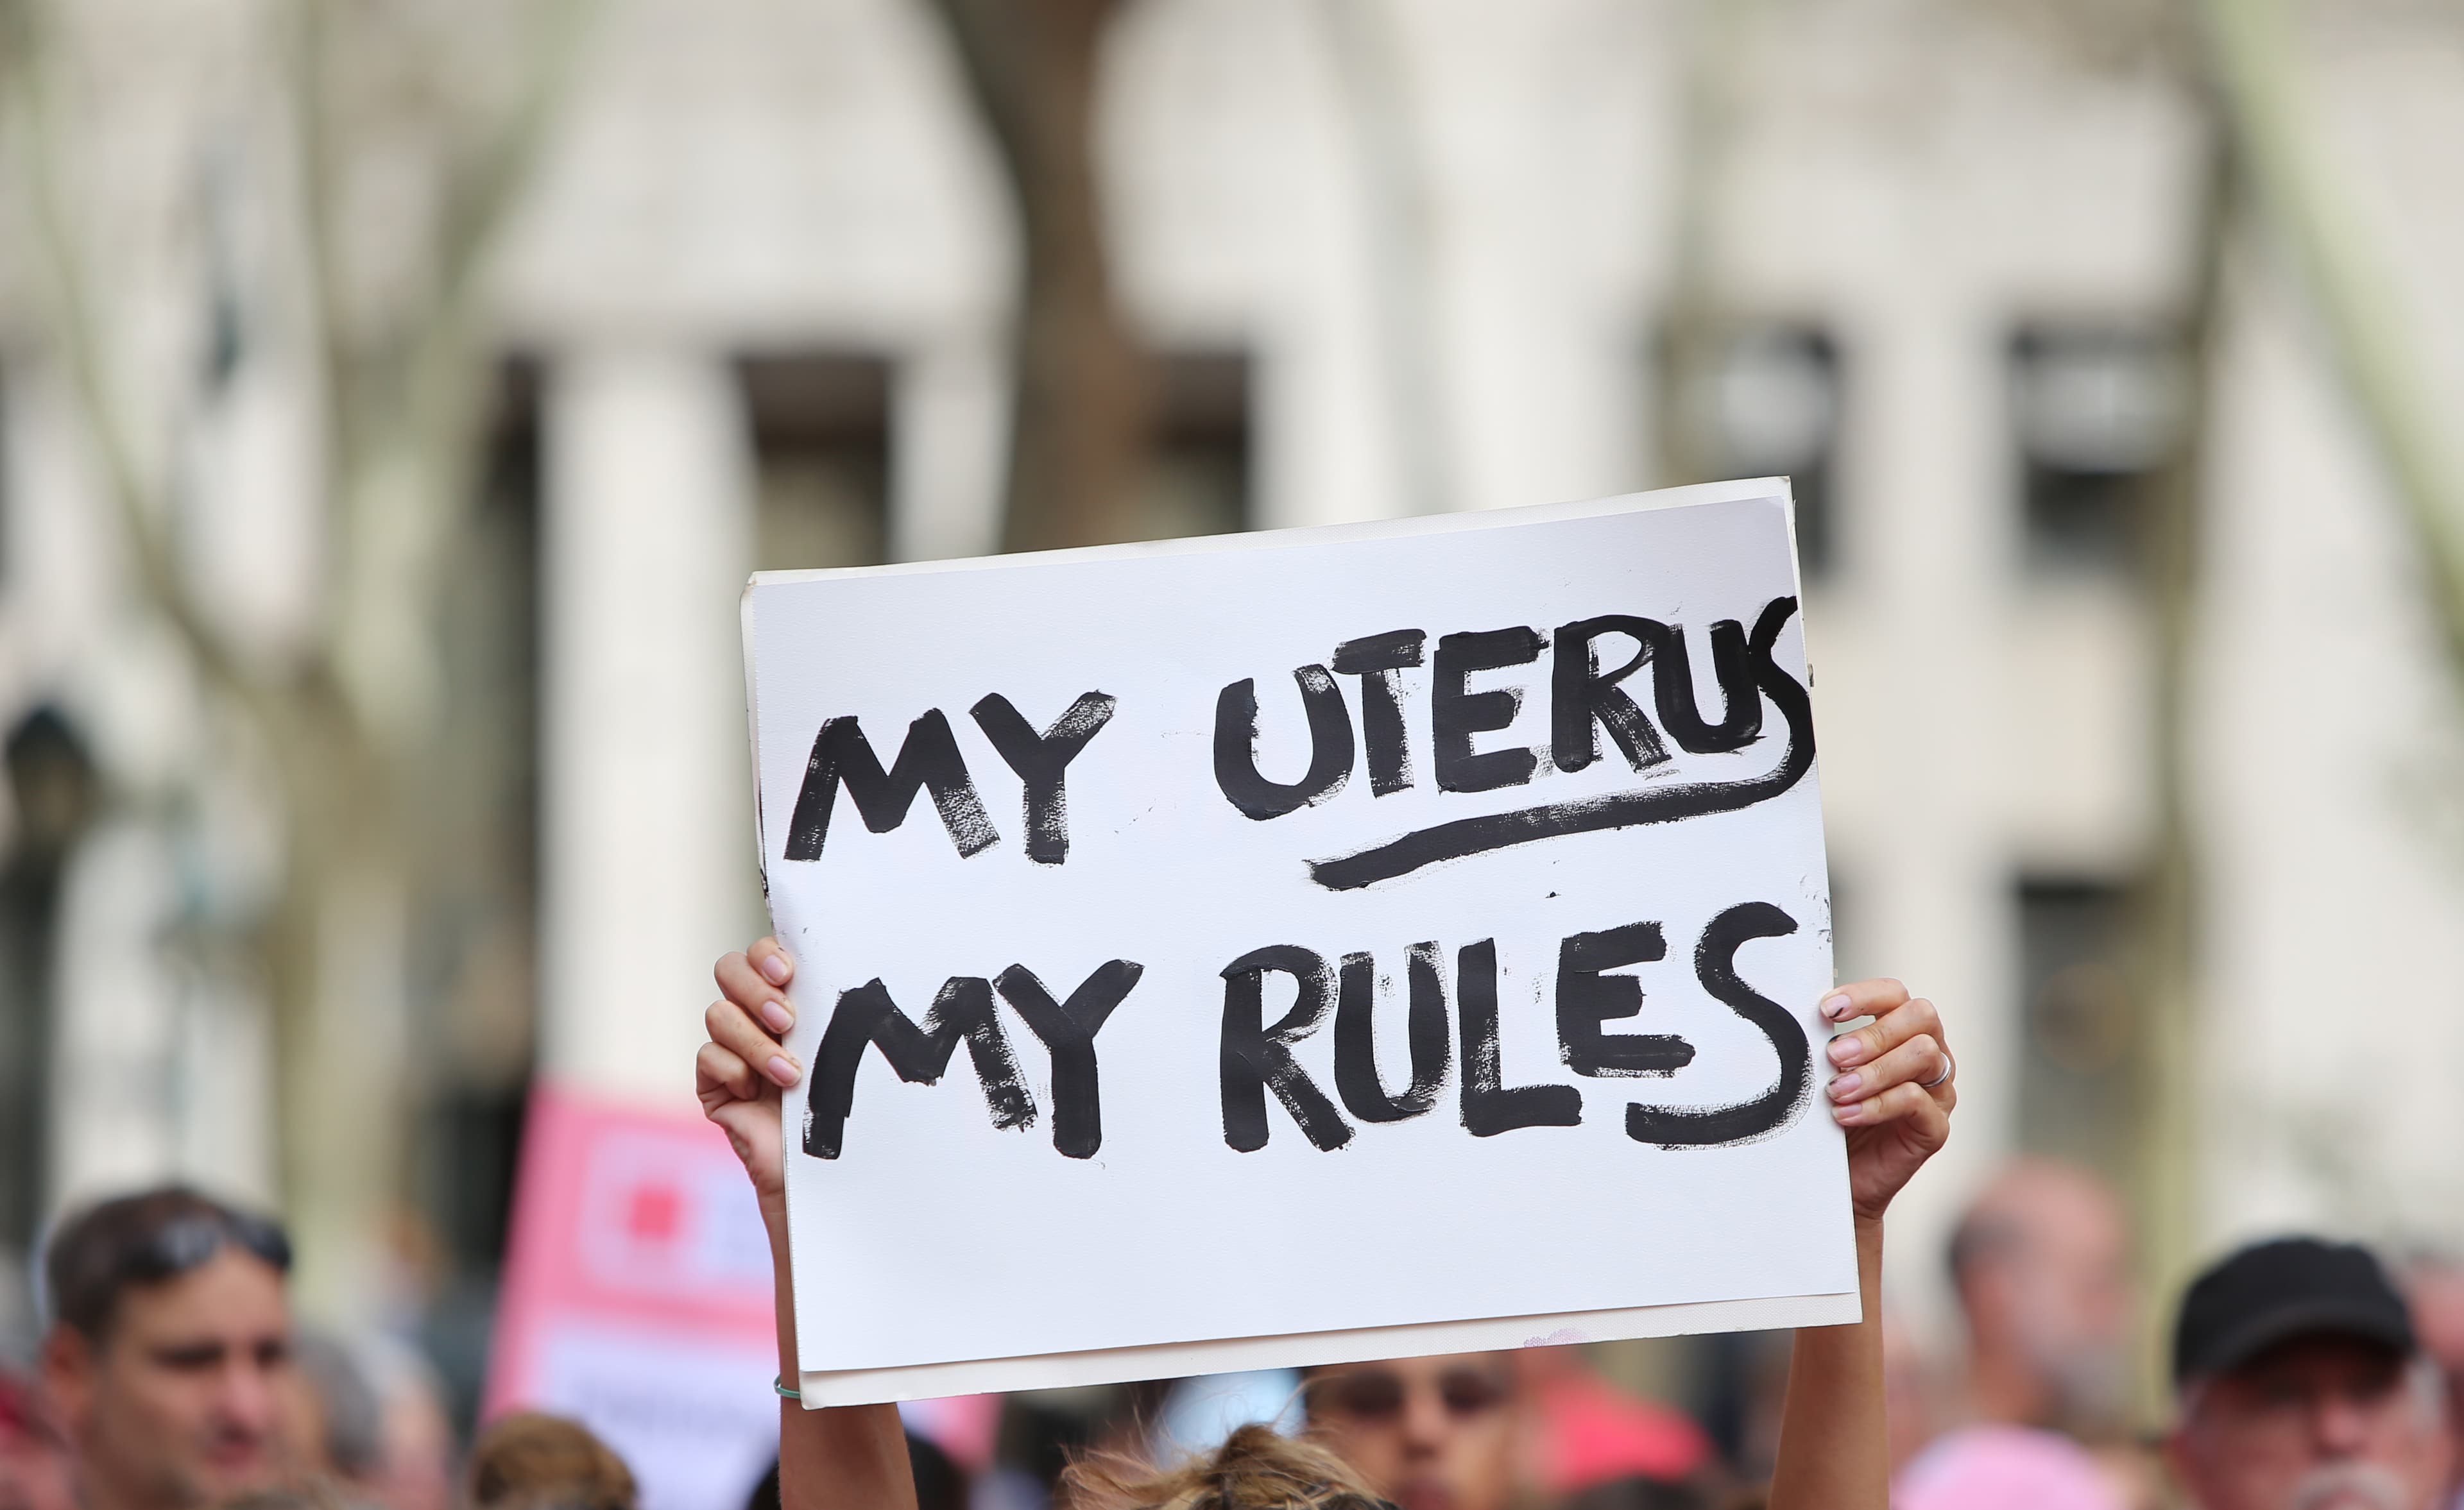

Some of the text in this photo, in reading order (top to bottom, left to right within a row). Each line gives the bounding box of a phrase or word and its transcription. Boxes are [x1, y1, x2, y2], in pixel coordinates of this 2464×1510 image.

[783, 596, 1816, 891] MY UTERUS
[803, 902, 1813, 1160] MY RULES
